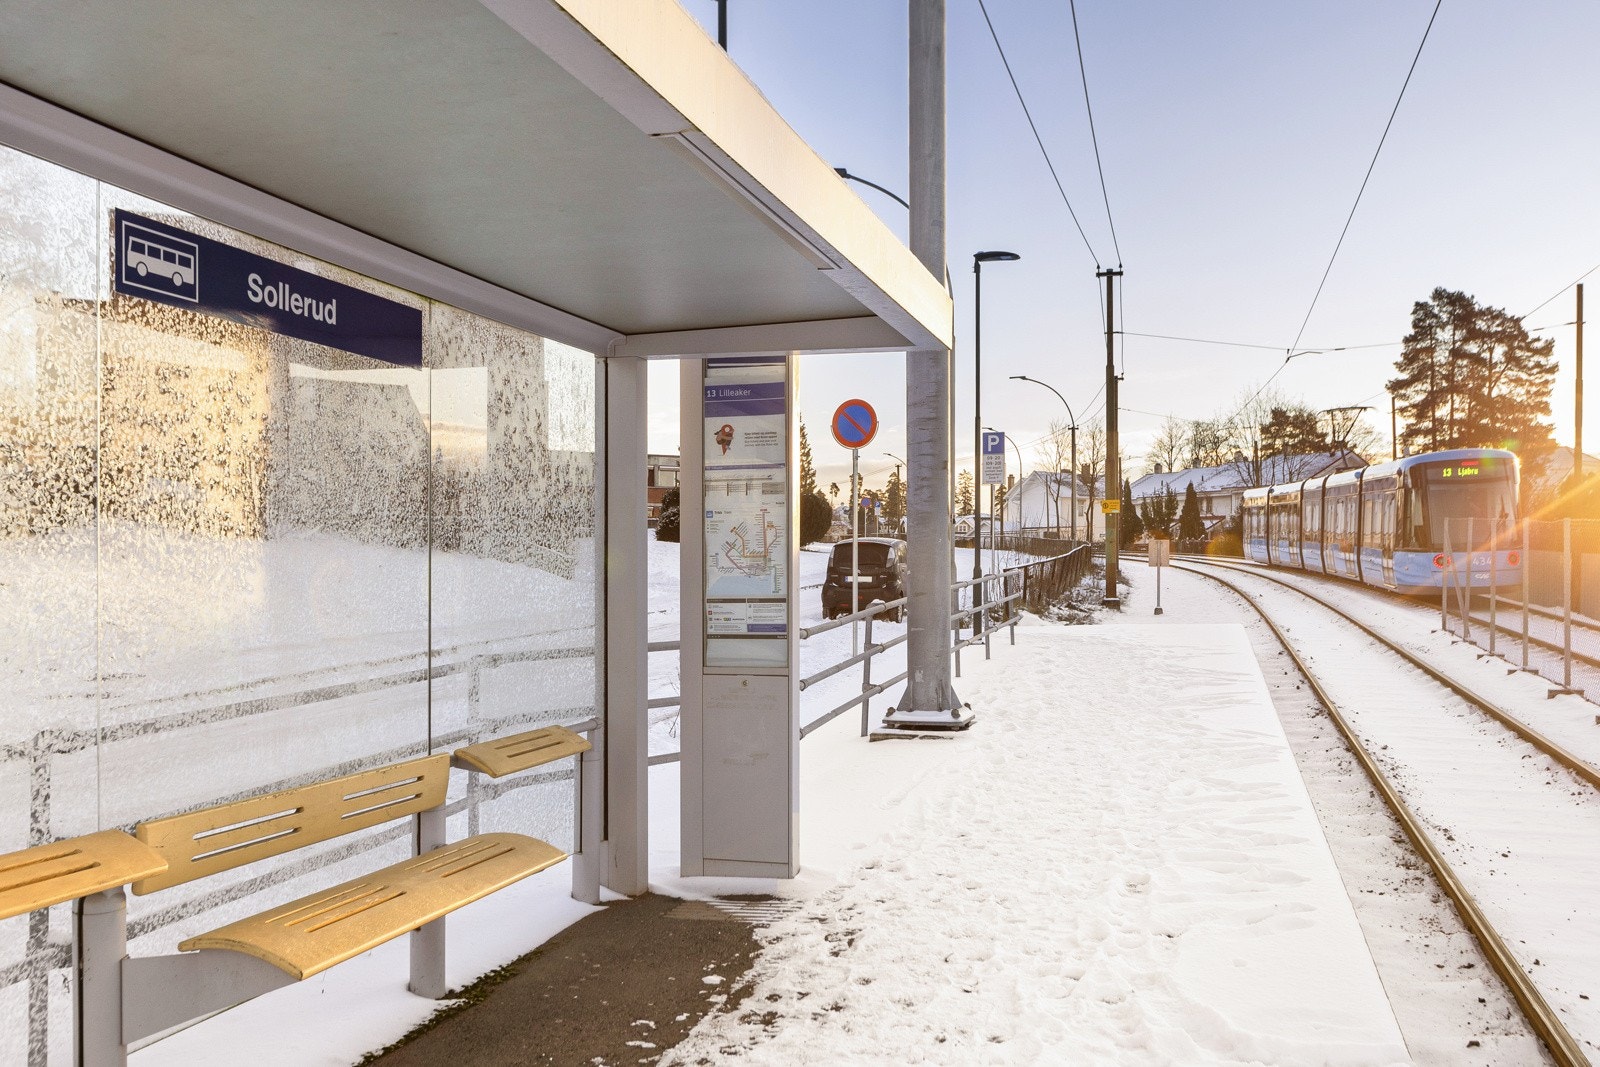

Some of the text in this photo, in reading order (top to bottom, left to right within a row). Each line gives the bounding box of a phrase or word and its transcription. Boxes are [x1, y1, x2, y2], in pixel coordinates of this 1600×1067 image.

[247, 272, 337, 326] Sollerud
[706, 388, 752, 398] 13 Lilleaker
[987, 434, 999, 452] P
[1442, 467, 1479, 477] 13 Ljabru
